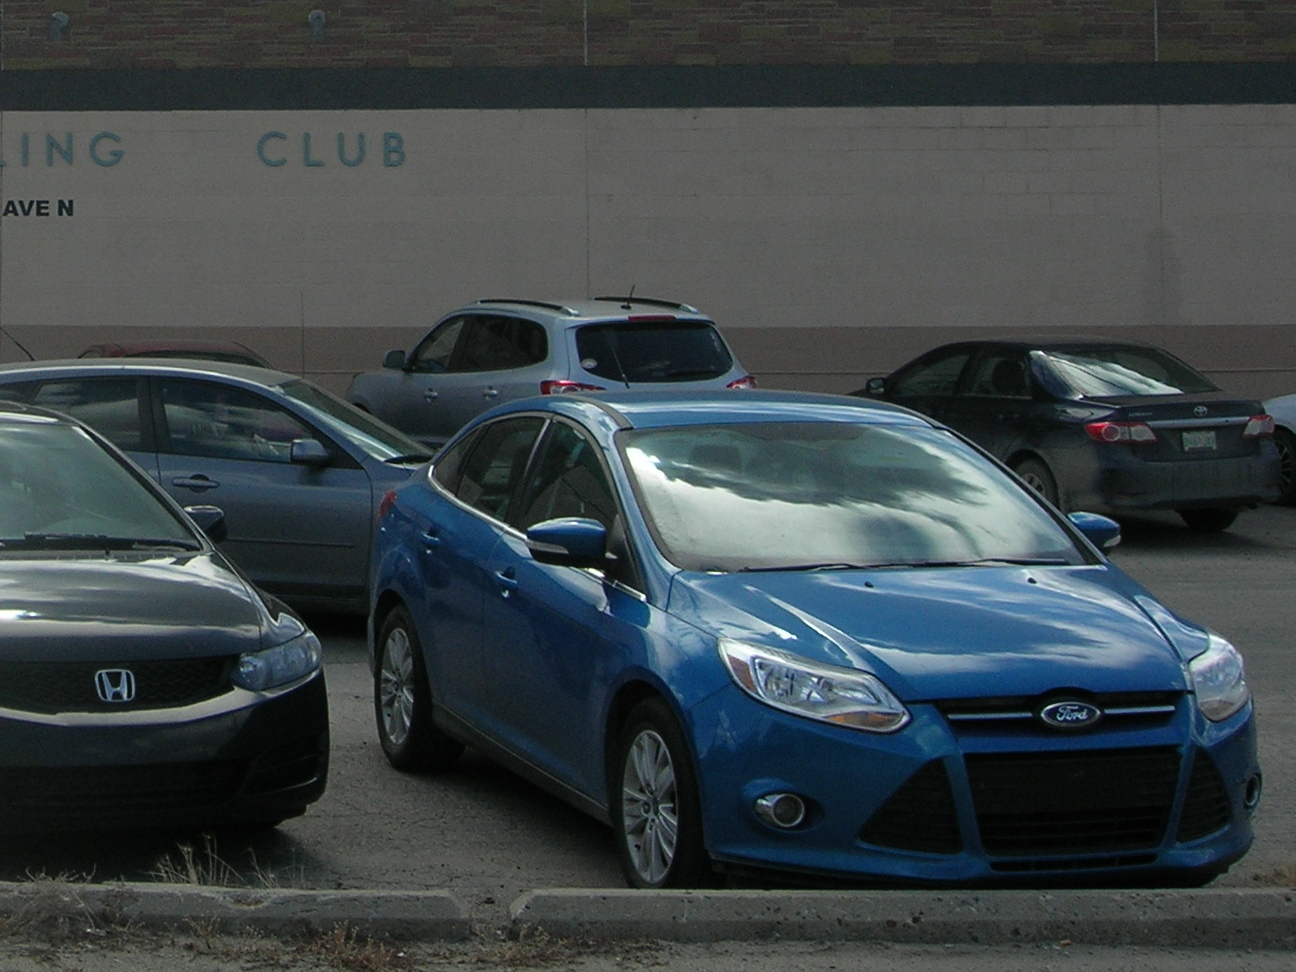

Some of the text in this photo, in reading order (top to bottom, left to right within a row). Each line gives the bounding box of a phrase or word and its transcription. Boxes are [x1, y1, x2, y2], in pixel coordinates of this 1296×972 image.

[257, 131, 406, 167] CLUB
[3, 199, 50, 217] AVE
[57, 199, 74, 217] N
[1056, 705, 1088, 721] Ford
